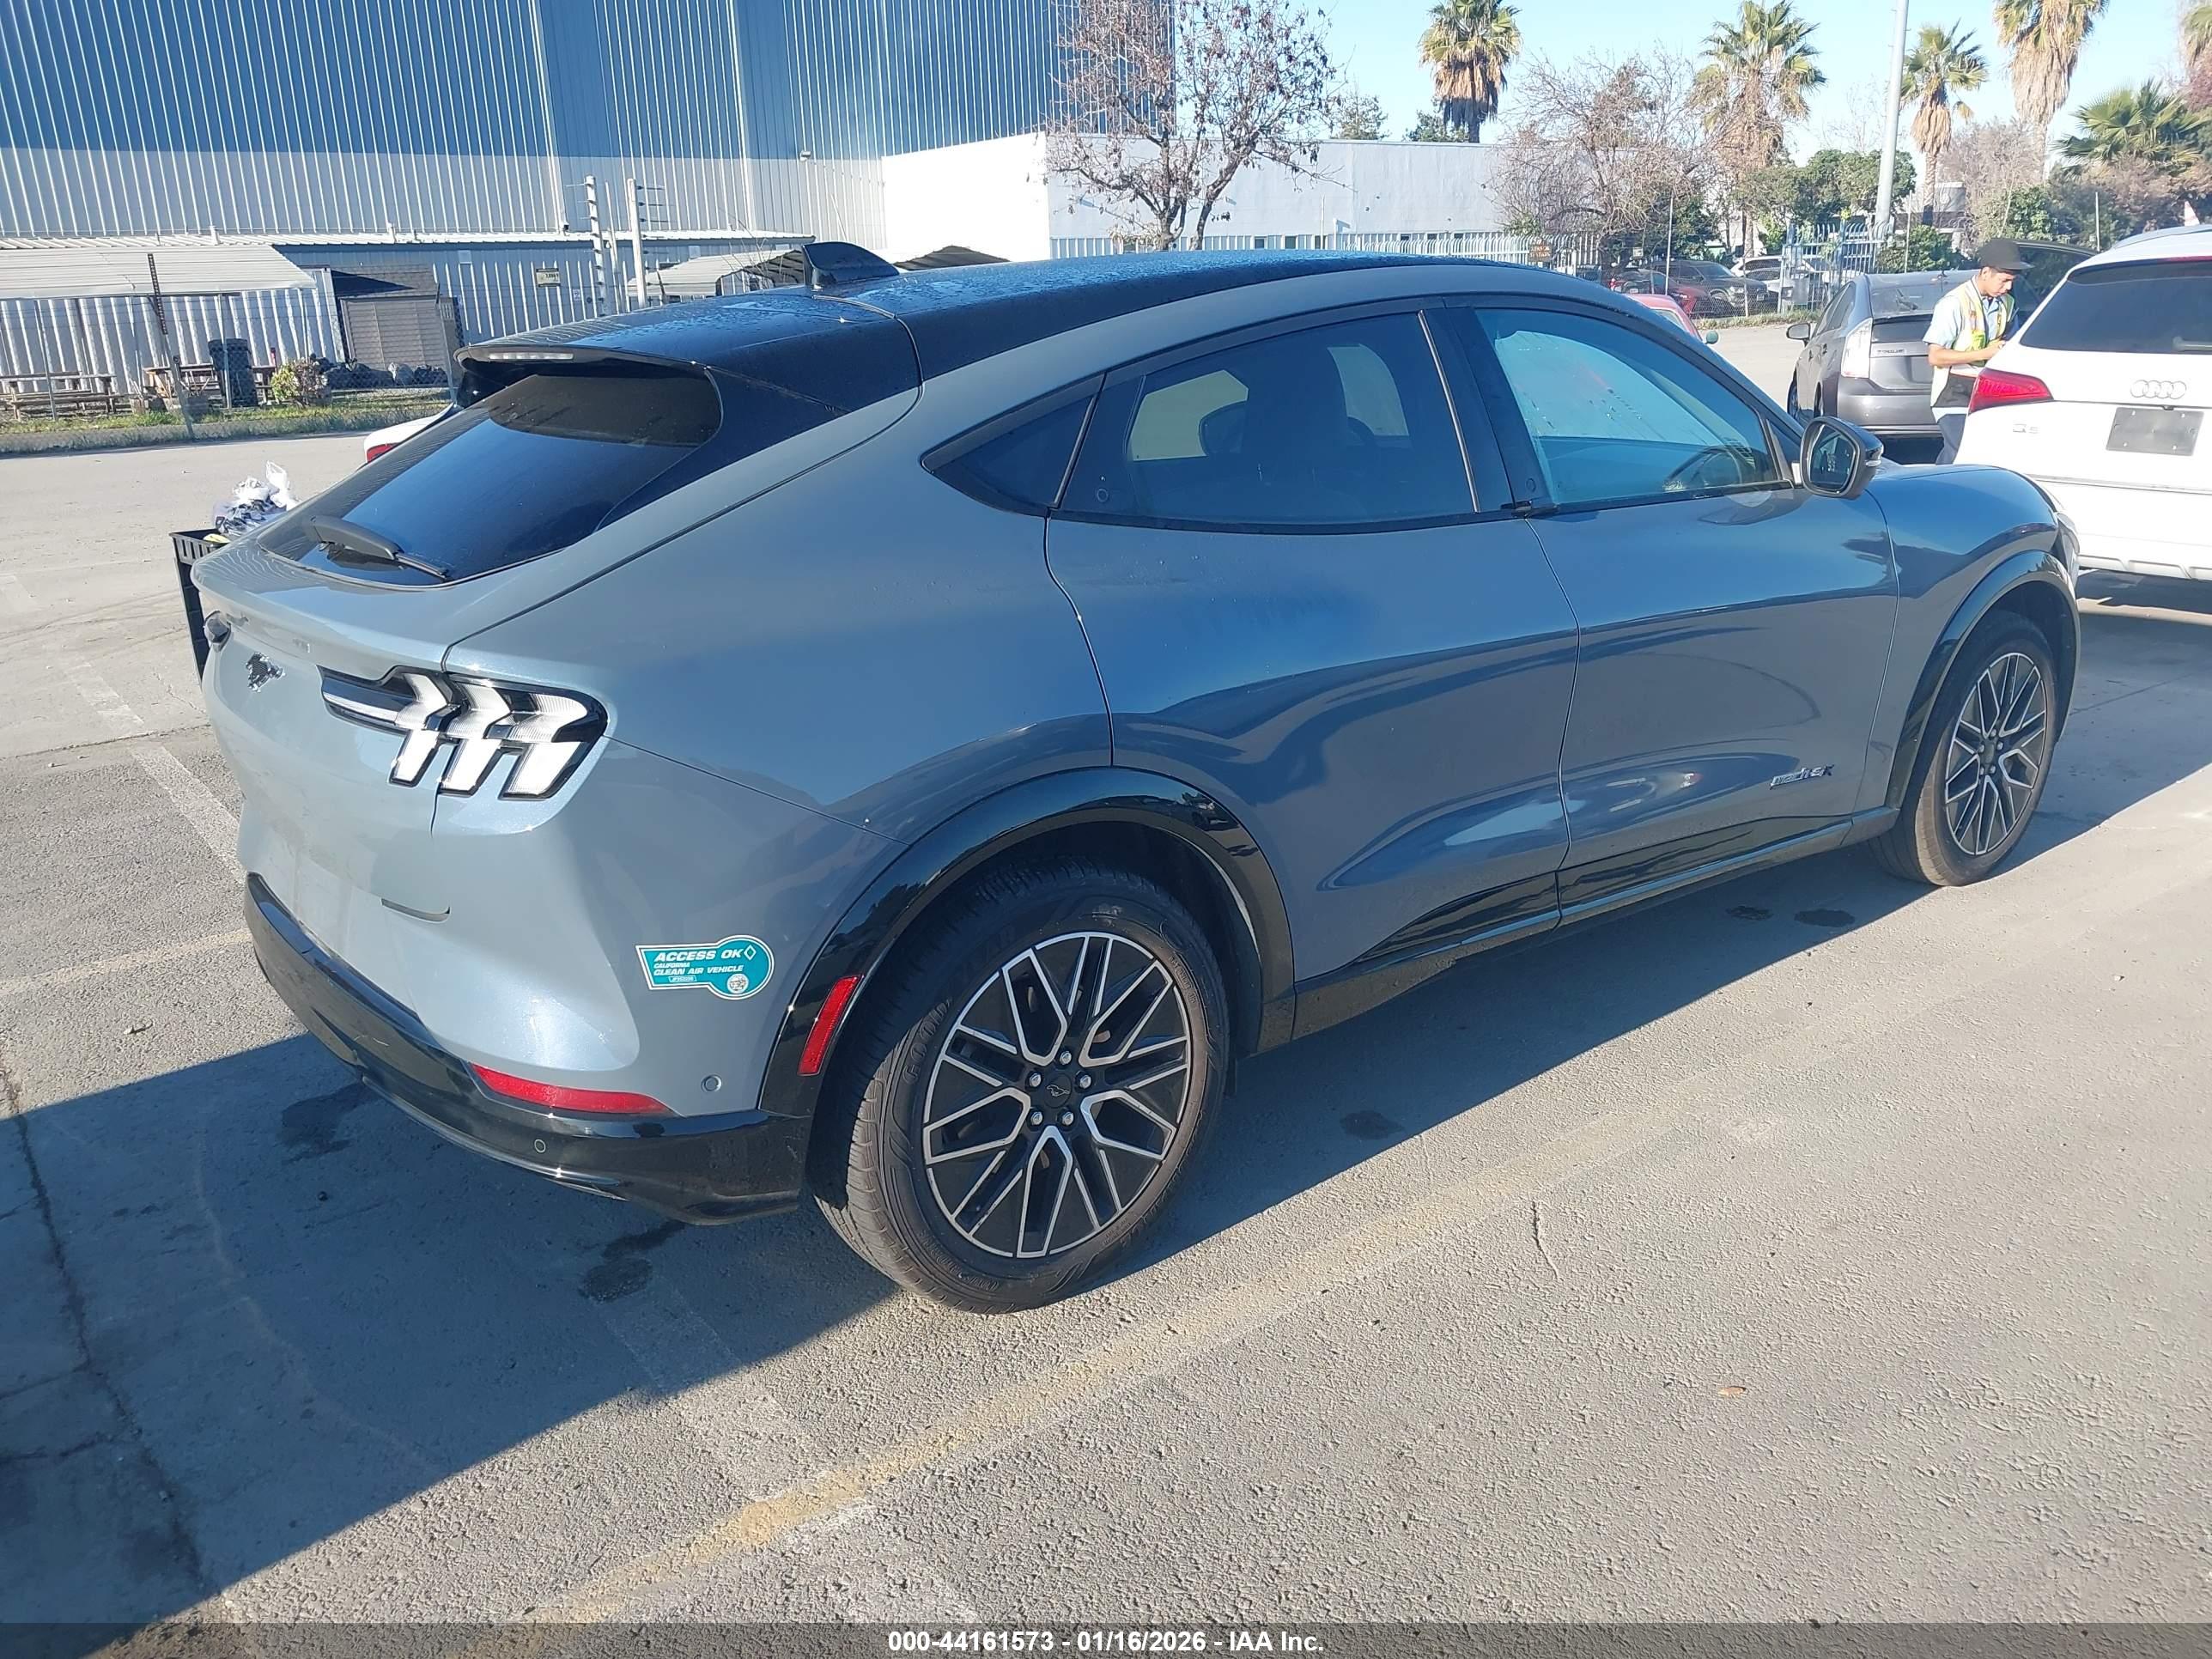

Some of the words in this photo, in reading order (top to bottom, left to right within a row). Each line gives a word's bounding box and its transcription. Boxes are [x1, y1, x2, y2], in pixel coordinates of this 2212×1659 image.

[653, 950, 717, 962] ACCESS
[720, 948, 744, 959] OK
[707, 964, 744, 974] VEHICLE
